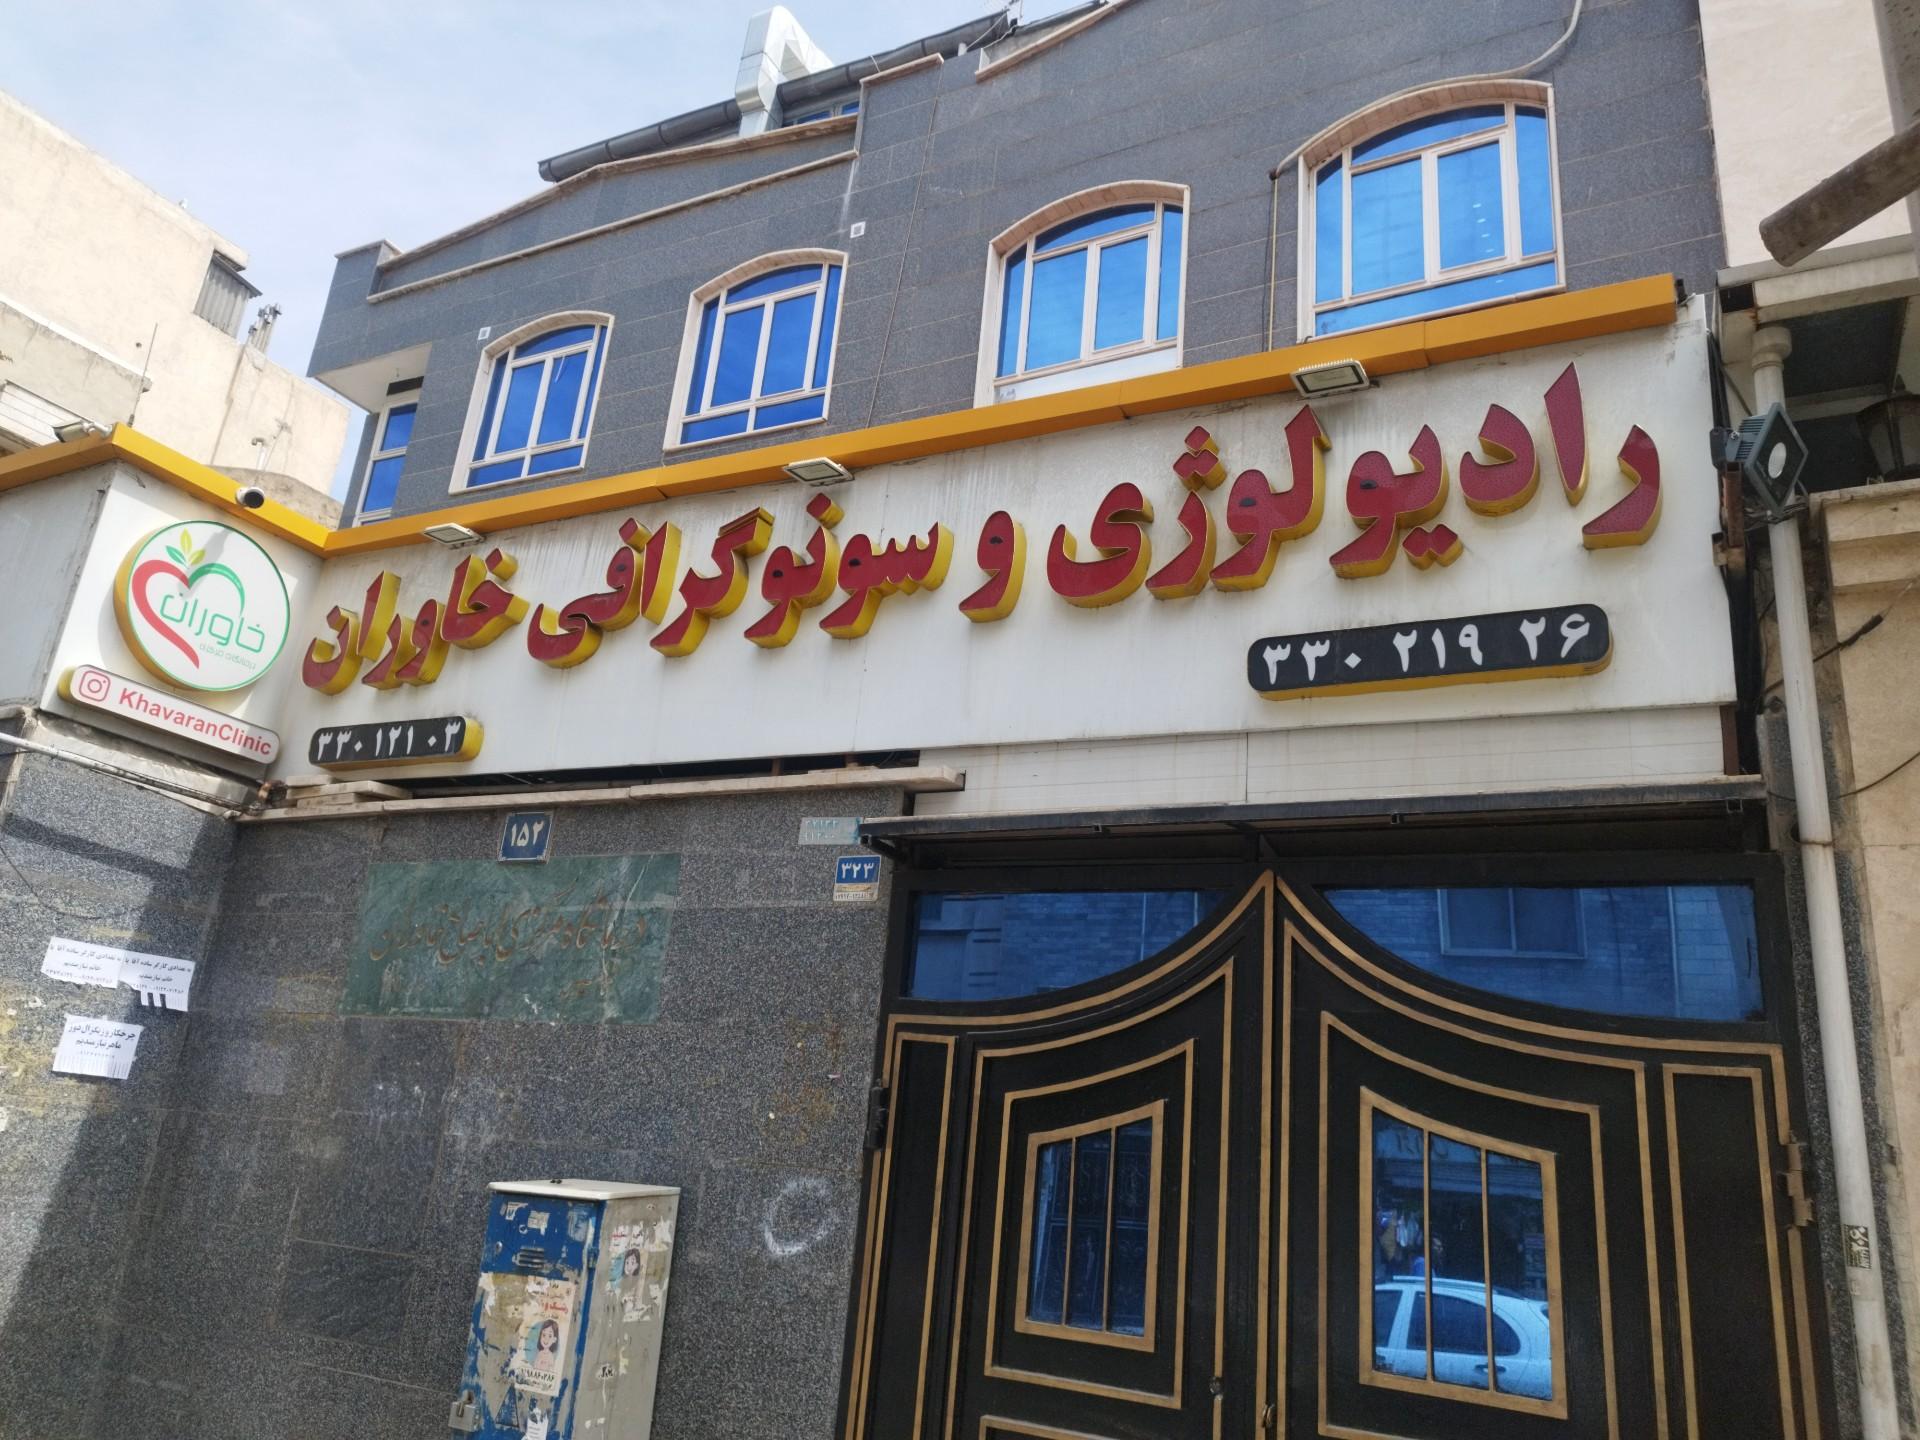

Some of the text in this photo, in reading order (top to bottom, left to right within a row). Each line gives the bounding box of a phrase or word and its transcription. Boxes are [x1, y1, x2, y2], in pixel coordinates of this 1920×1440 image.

[302, 362, 1662, 694] رادیولوژی و سونوگرافی خاوران
[160, 593, 265, 654] خاوران
[118, 686, 272, 756] KhavaranClinic
[509, 819, 547, 849] ۱۵۲
[841, 862, 875, 880] ۳۲۳
